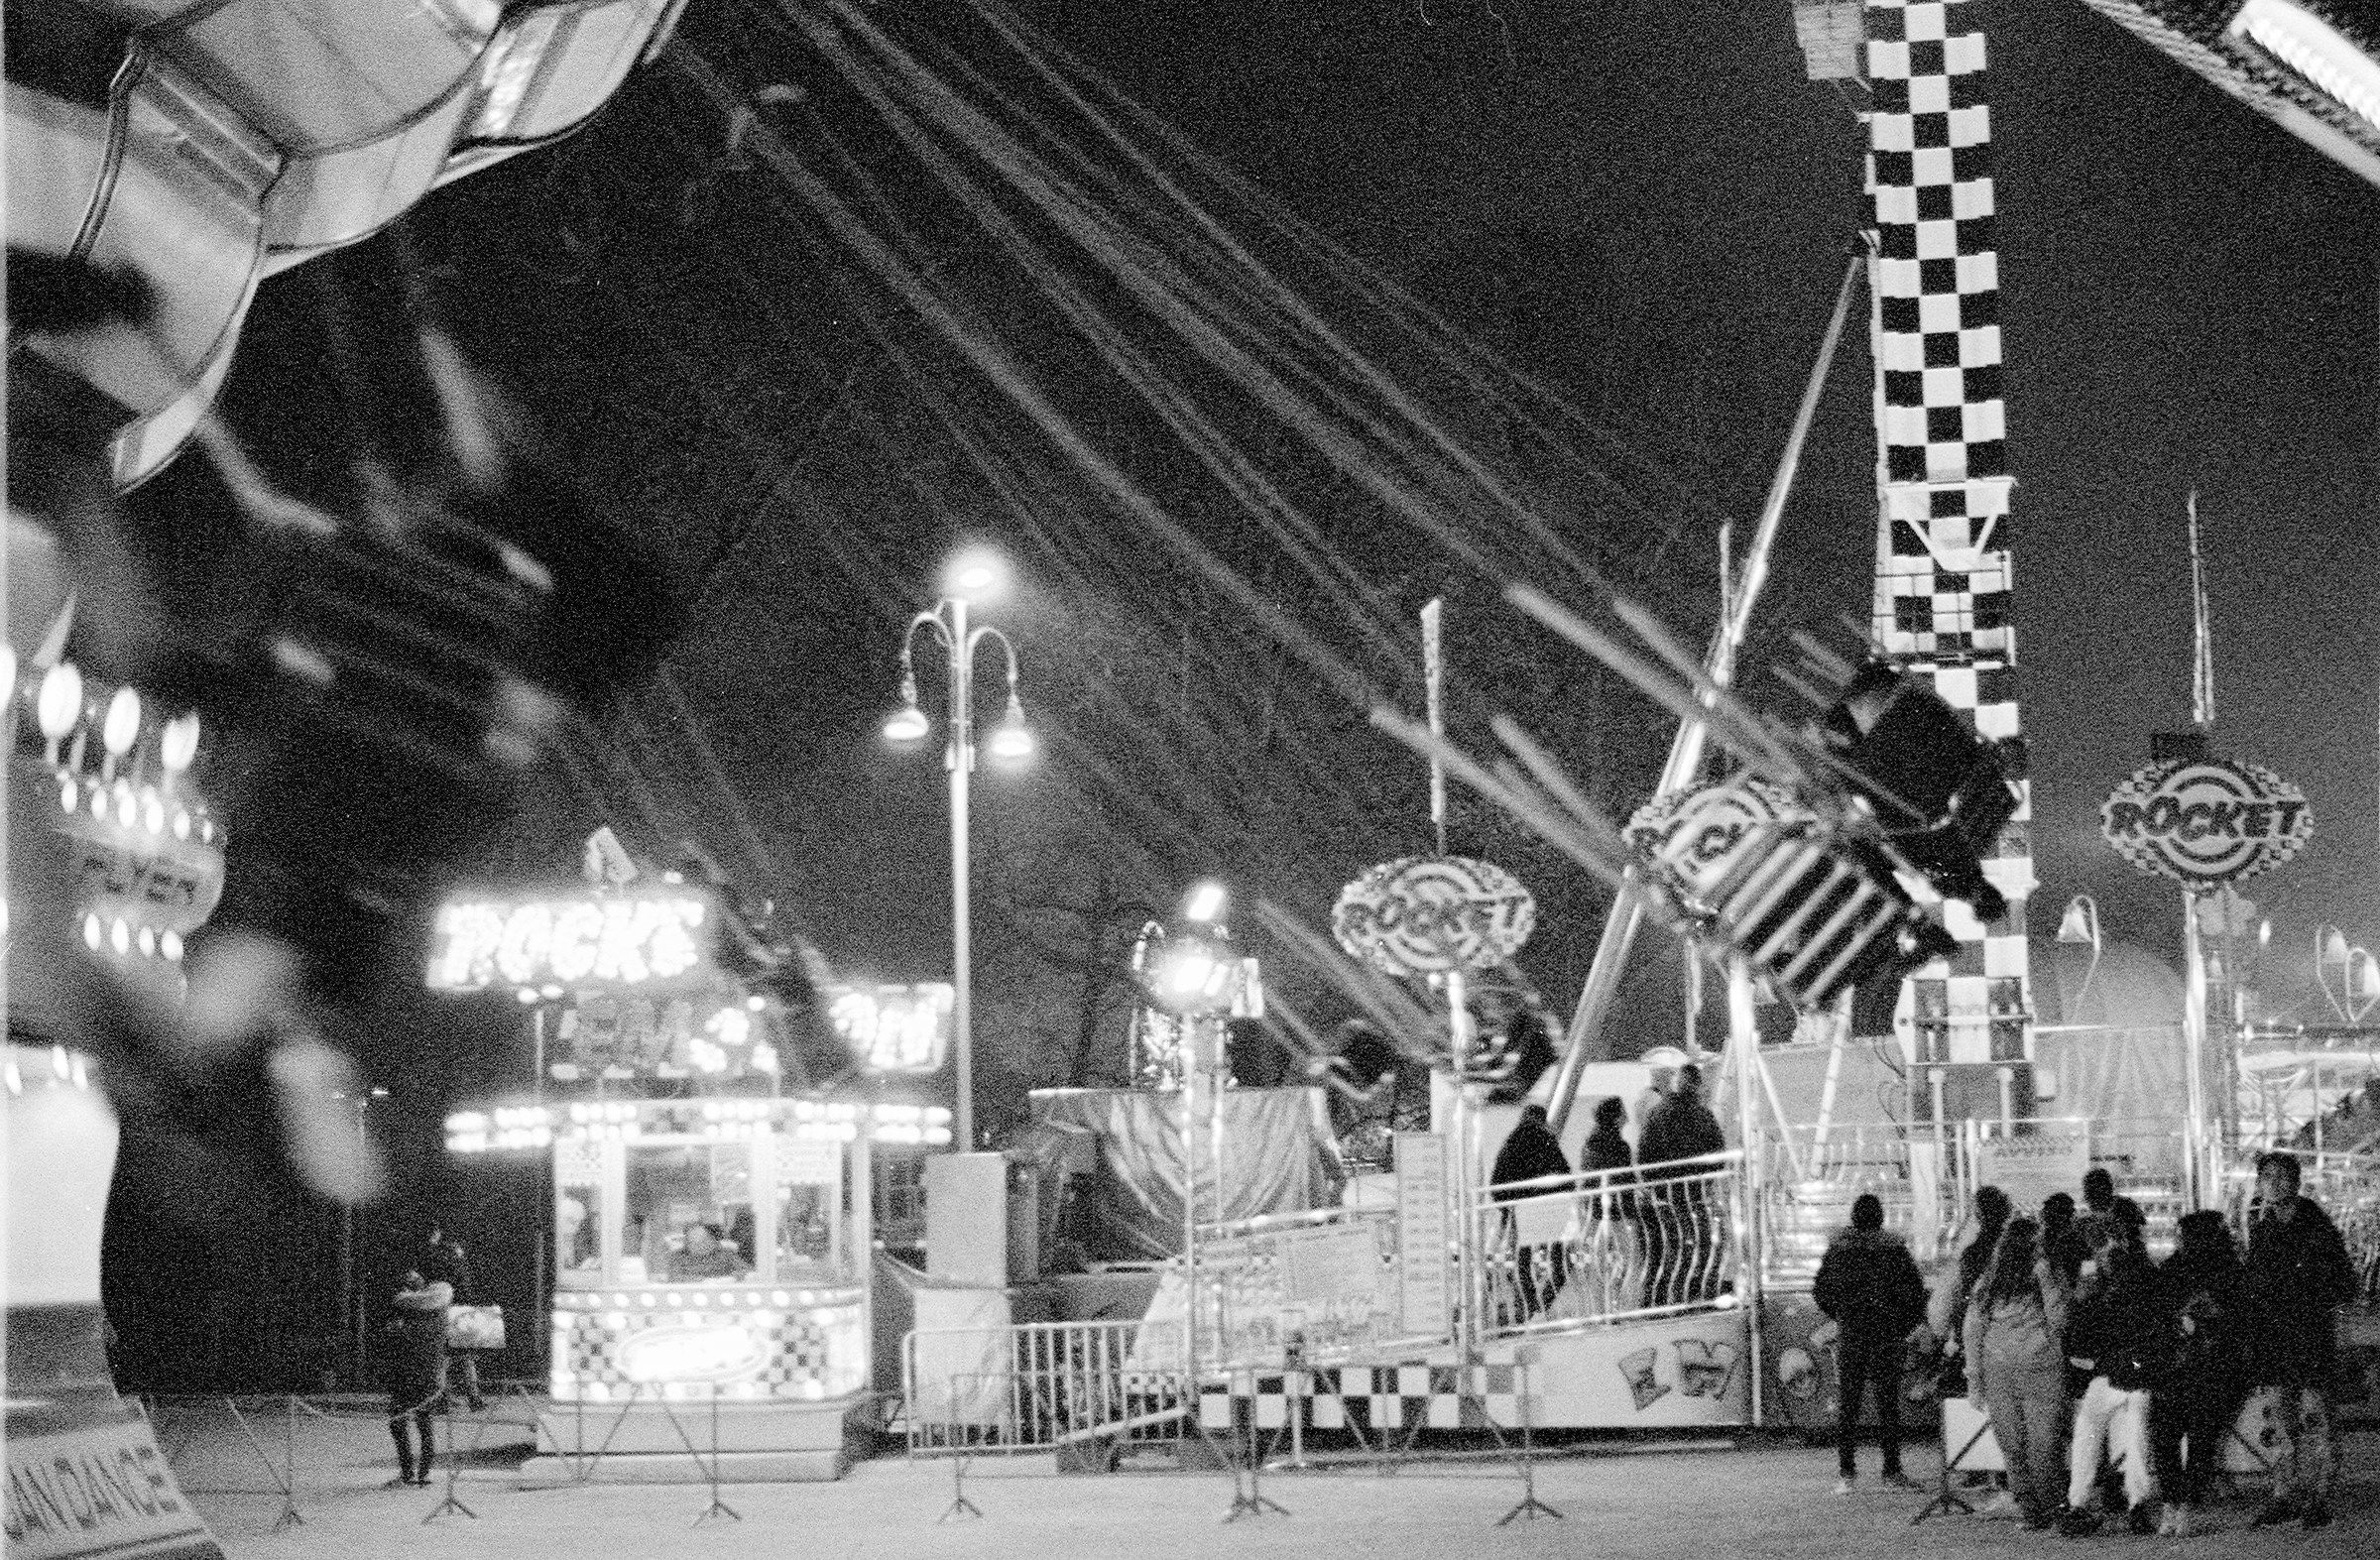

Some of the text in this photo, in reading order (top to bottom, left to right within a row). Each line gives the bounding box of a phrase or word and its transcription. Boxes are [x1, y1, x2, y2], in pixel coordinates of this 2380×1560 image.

[2109, 795, 2305, 842] ROCKET
[1341, 896, 1527, 938] ROCKET
[440, 900, 704, 982] ROCKE
[1993, 1145, 2073, 1157] AVVISO
